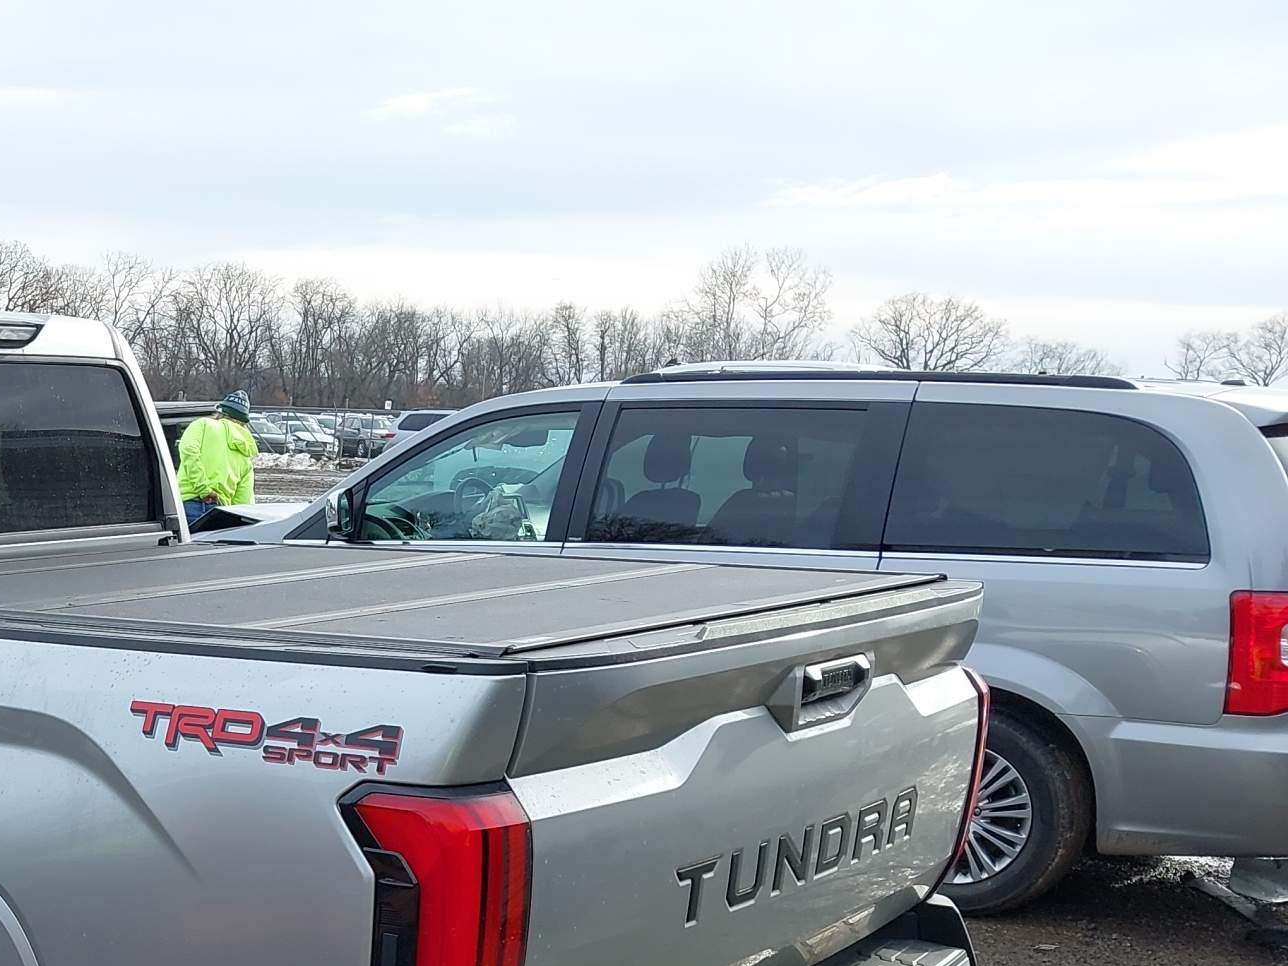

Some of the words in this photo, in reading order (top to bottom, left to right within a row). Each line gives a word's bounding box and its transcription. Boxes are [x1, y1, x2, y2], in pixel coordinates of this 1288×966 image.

[130, 700, 267, 757] TRD
[261, 744, 398, 776] SPORT
[674, 785, 919, 929] TUNDRA
